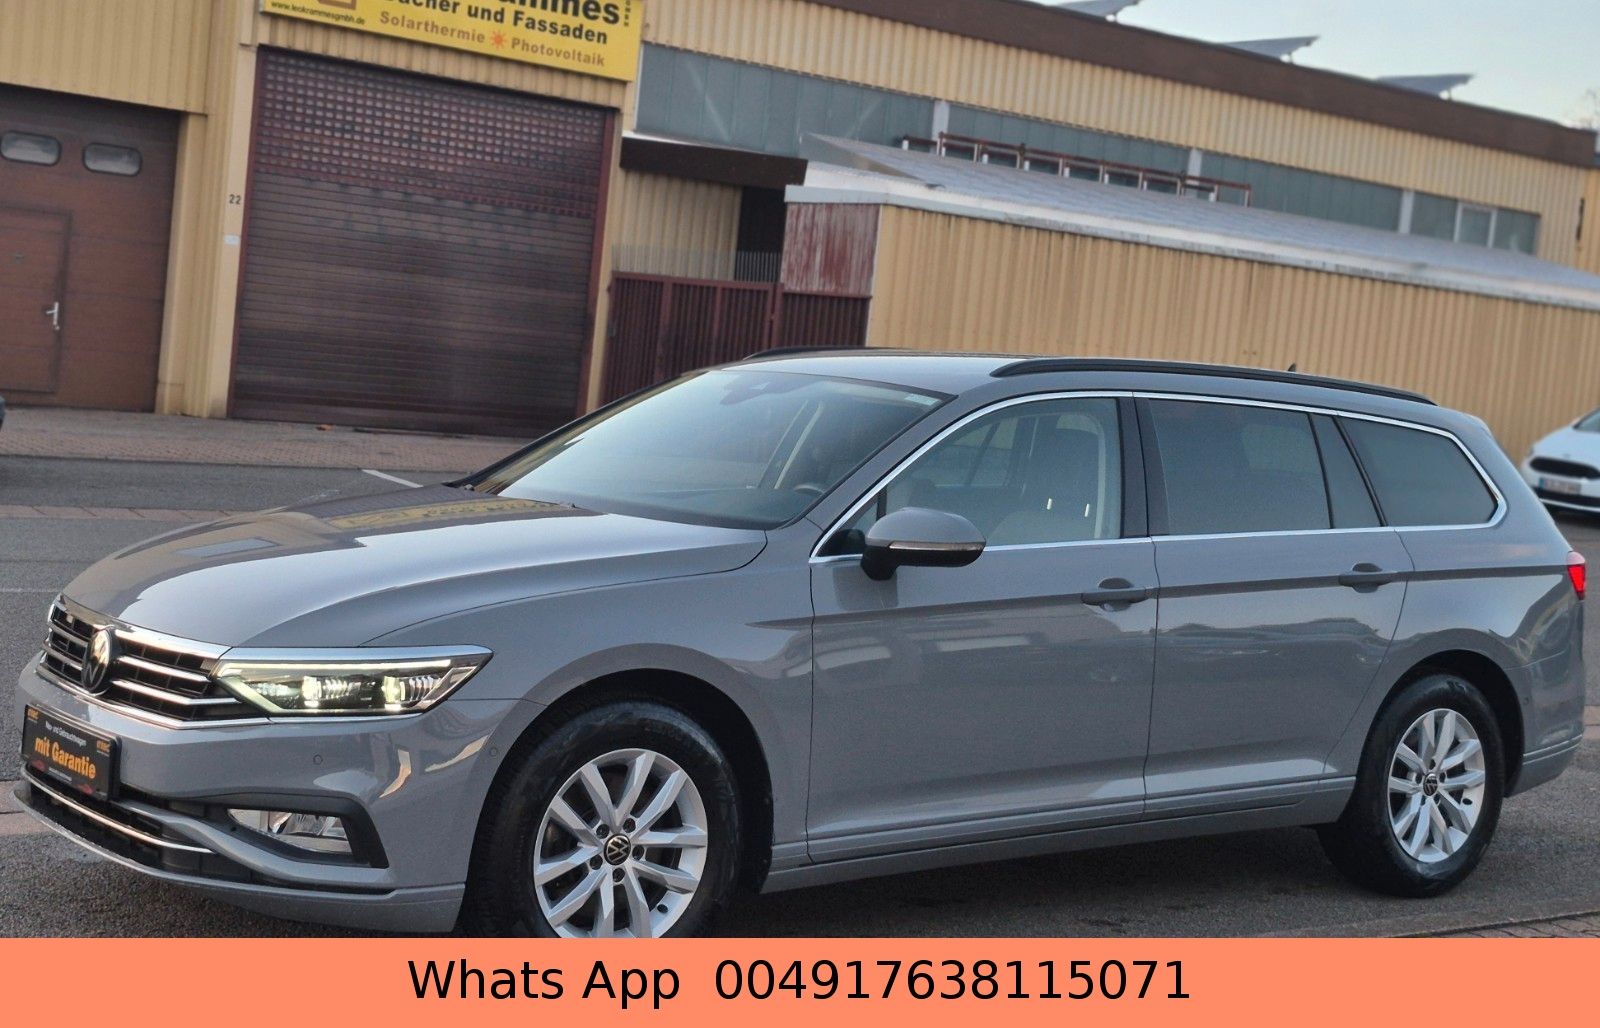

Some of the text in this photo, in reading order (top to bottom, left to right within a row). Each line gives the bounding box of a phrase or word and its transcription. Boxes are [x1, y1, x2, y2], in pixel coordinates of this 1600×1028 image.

[380, 11, 605, 66] Solarthermie Photovoltaik
[468, 5, 505, 23] und
[513, 11, 608, 44] Fassaden
[229, 194, 241, 205] 22
[34, 737, 50, 757] mit
[52, 741, 96, 779] Garantie
